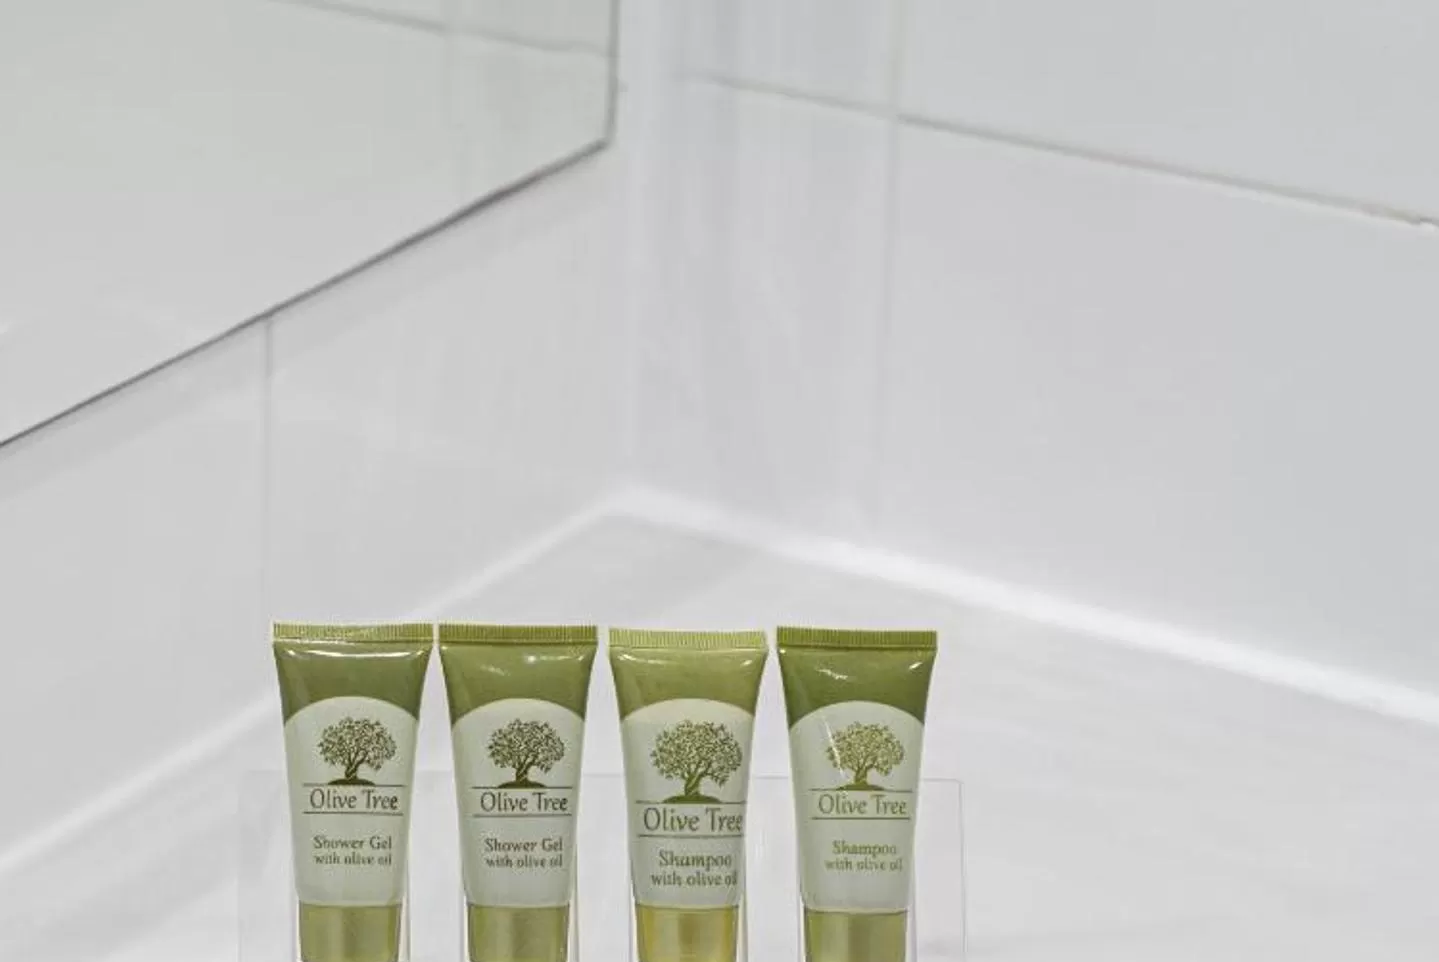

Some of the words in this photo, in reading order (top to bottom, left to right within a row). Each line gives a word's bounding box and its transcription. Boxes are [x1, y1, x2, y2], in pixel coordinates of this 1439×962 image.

[310, 788, 357, 809] Olive
[362, 788, 398, 810] Tree
[480, 791, 528, 812] Olive
[532, 792, 568, 812] Tree
[818, 793, 868, 815] Olive
[871, 793, 907, 815] Tree
[644, 807, 700, 832] Olive
[705, 807, 743, 832] Tree
[313, 834, 364, 849] Shower
[369, 835, 392, 850] Gel
[484, 837, 537, 852] Shower
[541, 836, 563, 852] Gel
[832, 839, 897, 859] Shampoo
[485, 854, 513, 868] with
[658, 848, 733, 872] Shampoo
[651, 871, 682, 886] with
[686, 871, 722, 886] olive
